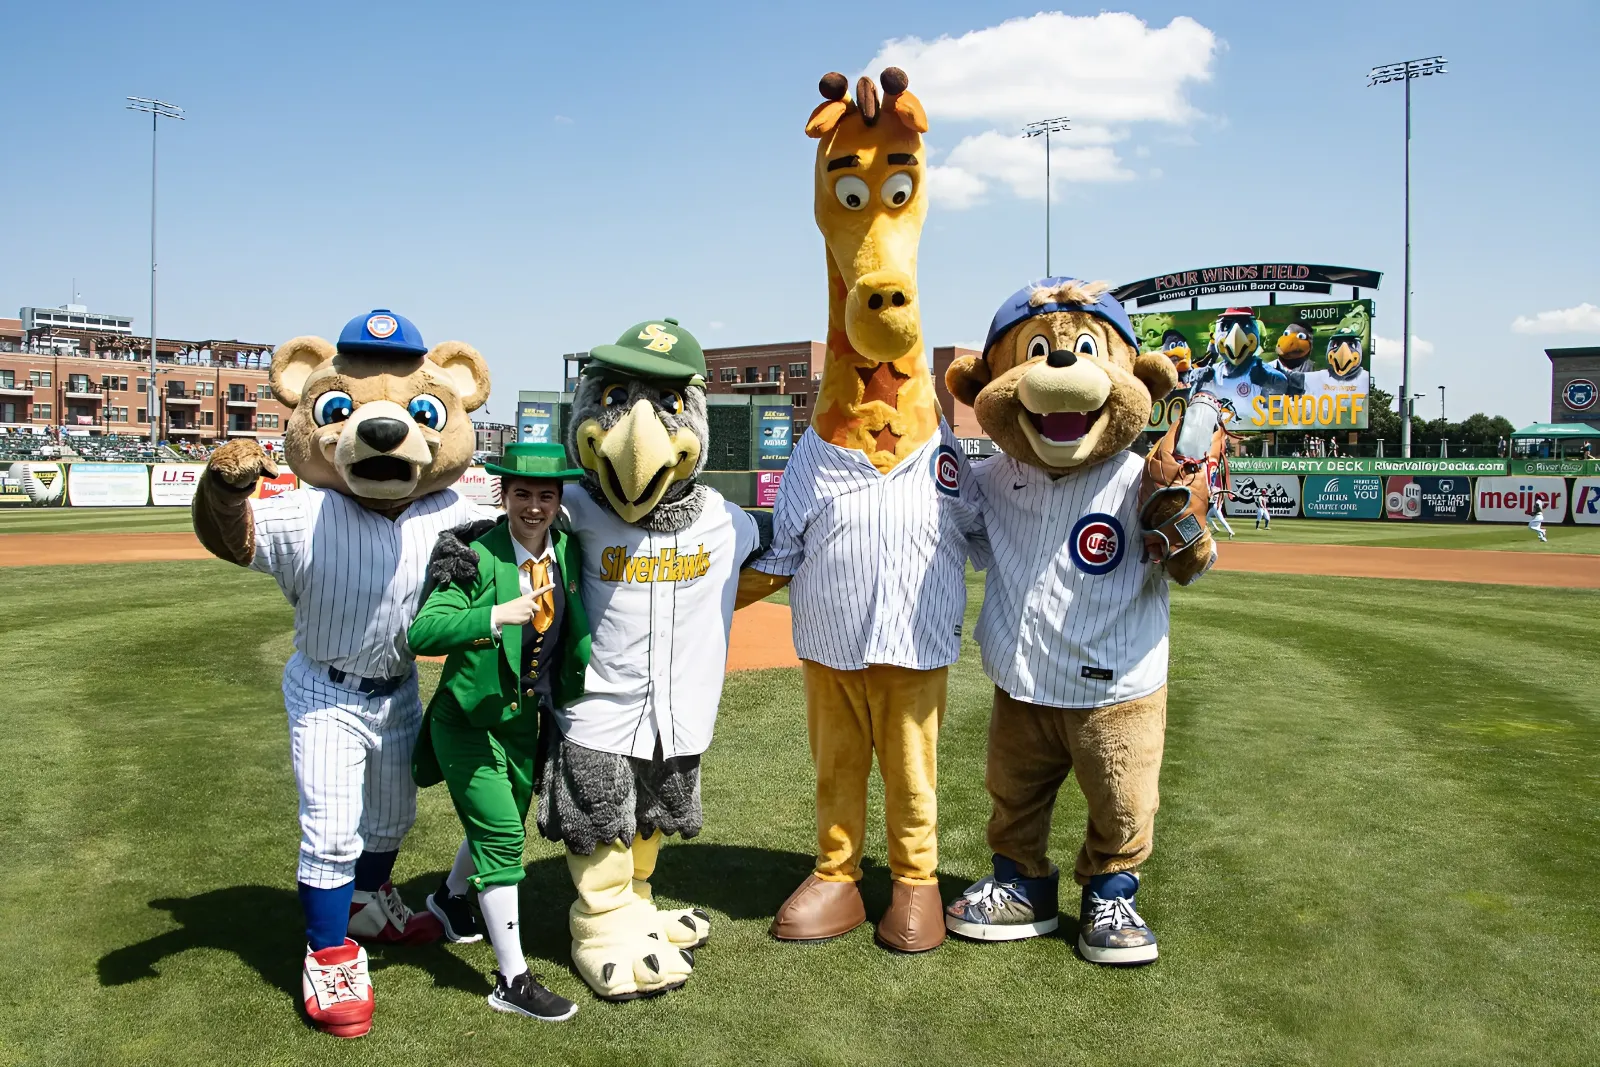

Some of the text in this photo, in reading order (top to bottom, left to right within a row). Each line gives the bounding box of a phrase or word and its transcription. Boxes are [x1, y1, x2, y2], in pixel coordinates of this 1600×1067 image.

[1155, 264, 1310, 290] FOUR WINDS FIELD
[1159, 291, 1186, 301] Home
[1188, 287, 1199, 296] of
[1201, 285, 1216, 293] the
[1219, 283, 1247, 292] South
[1278, 282, 1305, 290] Cubs
[1300, 307, 1339, 320] SWOOP!
[1251, 393, 1366, 426] SENDOFF
[958, 439, 980, 454] ICS
[1281, 461, 1363, 471] PARTY DECK
[1374, 460, 1504, 472] RiverValleyDecks.com
[1354, 491, 1378, 499] YOU
[1480, 485, 1561, 515] meijer
[1308, 503, 1358, 512] CARPET ONE
